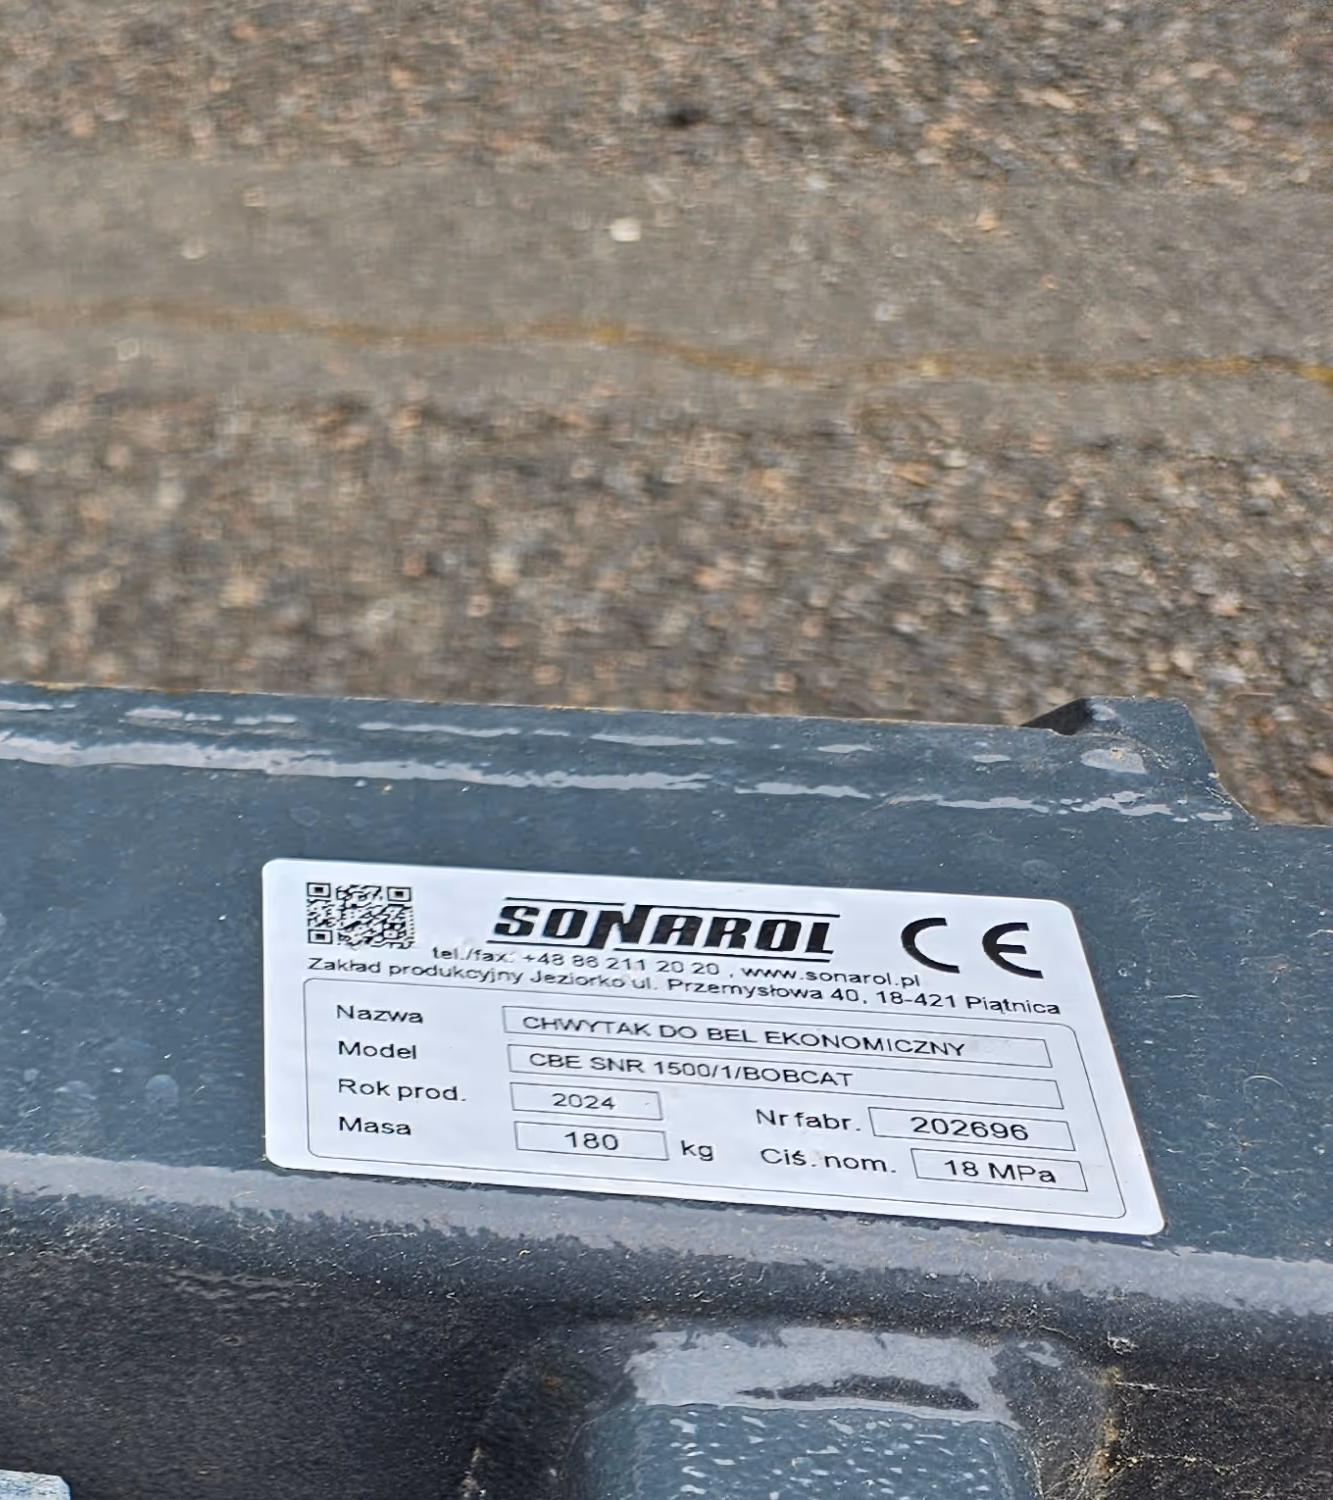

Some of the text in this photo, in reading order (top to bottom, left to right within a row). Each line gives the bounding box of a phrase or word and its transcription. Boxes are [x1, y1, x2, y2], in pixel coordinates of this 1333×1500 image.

[486, 898, 839, 961] SONAROL
[523, 952, 565, 966] +48
[606, 957, 646, 972] 211
[656, 961, 684, 973] 20
[691, 962, 720, 976] 20
[741, 967, 921, 988] www.sonarol.pl
[307, 957, 381, 974] Zakład
[388, 963, 523, 986] produkcyjny
[530, 970, 625, 988] Jeziorko
[633, 977, 658, 991] ul.
[667, 979, 823, 1001] Przemysłowa
[876, 991, 957, 1009] 18-421
[965, 996, 1061, 1015] Piątnica
[336, 1004, 423, 1024] Nazwa
[522, 1016, 965, 1057] CHWYTAK DO BEL EKONOMICZNY
[338, 1041, 417, 1059] Model
[530, 1053, 853, 1087] CBE SNR 1500/1/BOBCAT
[338, 1078, 467, 1102] Rok prod.
[551, 1092, 616, 1110] 2024
[338, 1117, 412, 1136] Masa
[756, 1109, 862, 1133] Nr fabr.
[910, 1116, 1029, 1142] 202696
[564, 1131, 714, 1162] 180 kg
[824, 1157, 897, 1173] nom.
[944, 1160, 1057, 1183] 18 MPa
